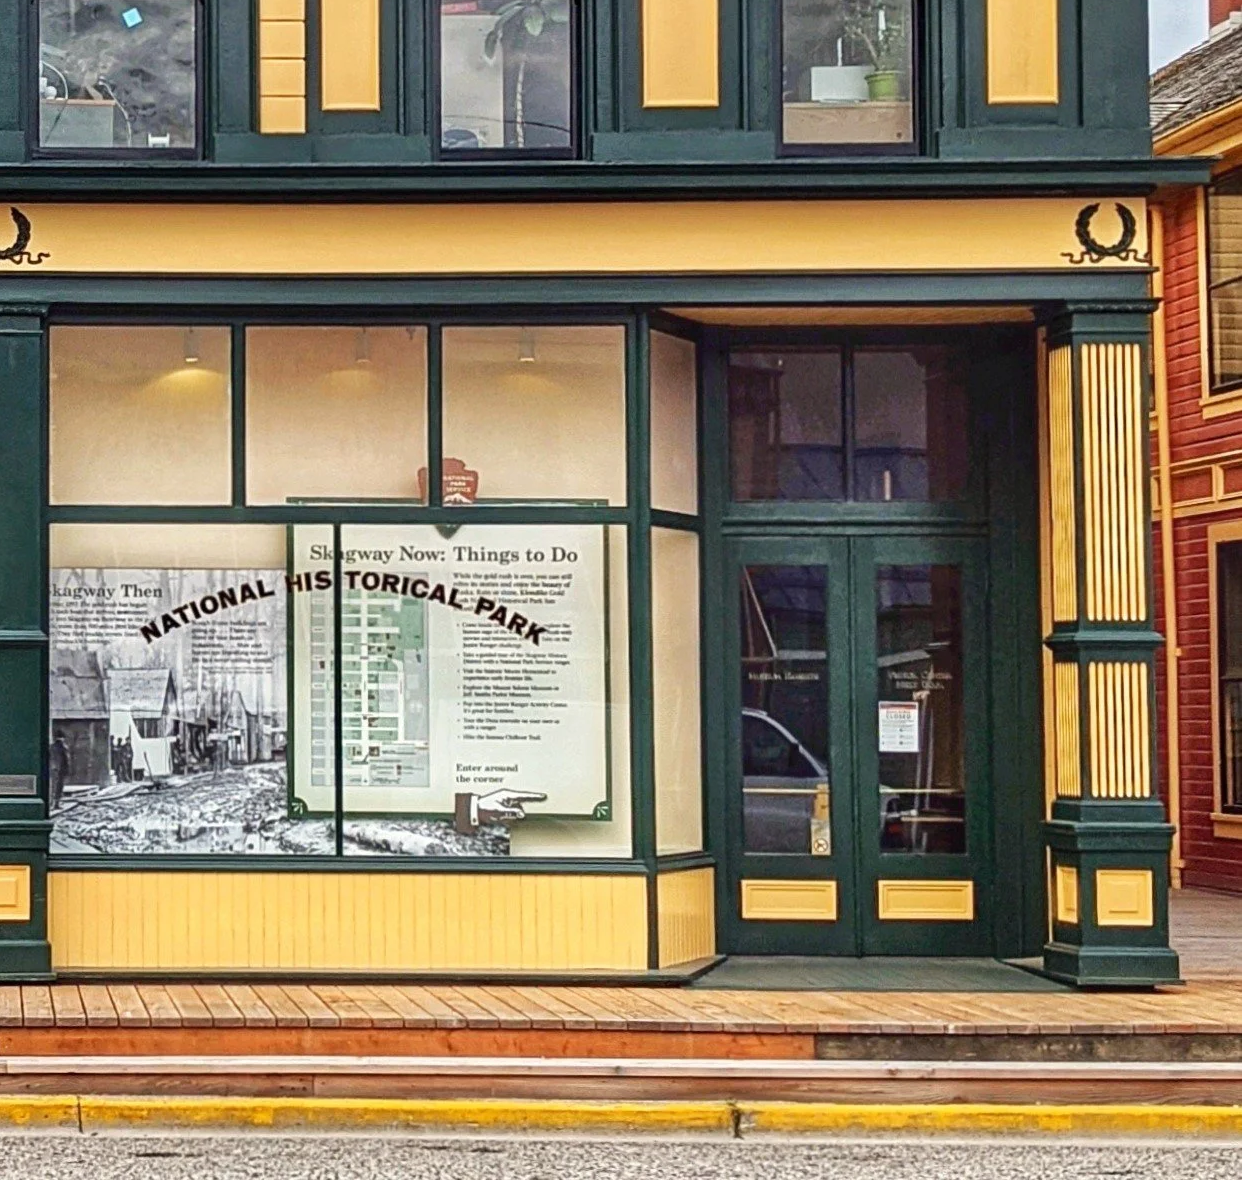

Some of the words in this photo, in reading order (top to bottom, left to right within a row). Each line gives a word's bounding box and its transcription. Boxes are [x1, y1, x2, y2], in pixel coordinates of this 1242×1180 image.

[310, 545, 393, 564] Skgway
[399, 546, 446, 562] Now:
[453, 546, 519, 565] Things
[526, 548, 544, 562] to
[550, 546, 578, 562] Do
[50, 583, 115, 600] kagway
[121, 584, 163, 598] Then
[139, 580, 275, 644] NATIONAL
[474, 596, 547, 647] PARK
[456, 764, 482, 772] Enter
[484, 764, 518, 772] around
[456, 775, 470, 783] the
[474, 775, 503, 783] corner
